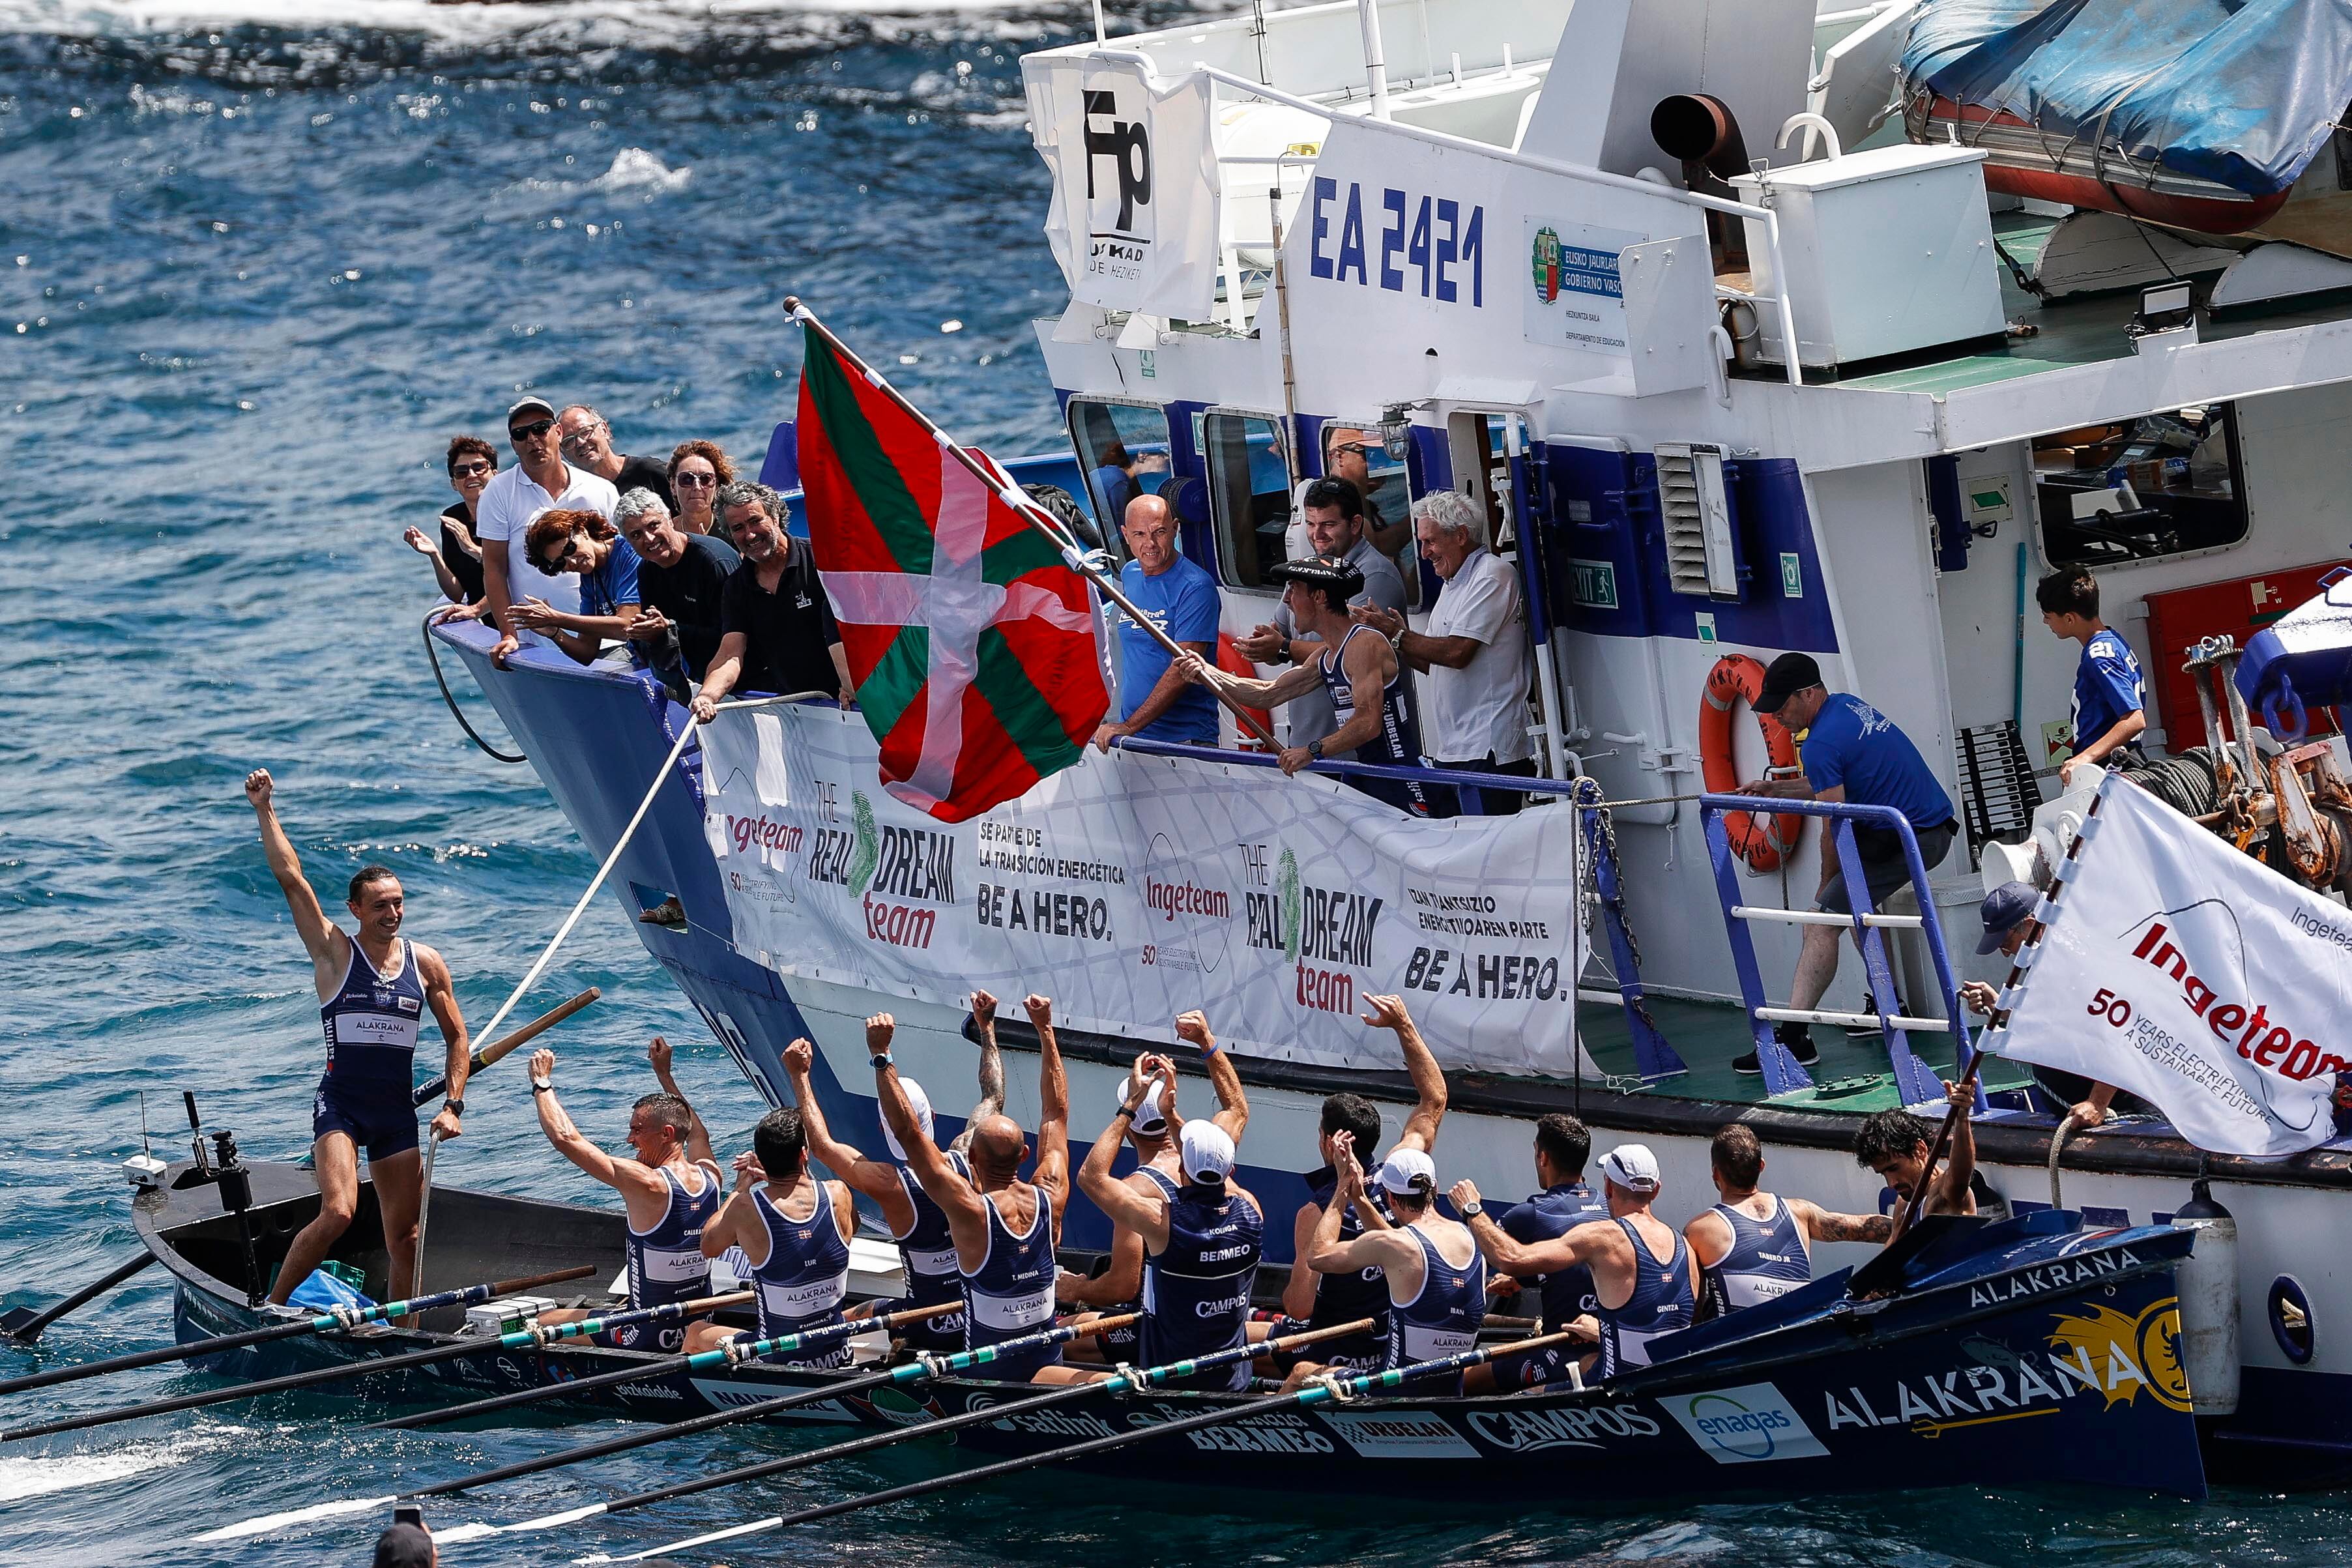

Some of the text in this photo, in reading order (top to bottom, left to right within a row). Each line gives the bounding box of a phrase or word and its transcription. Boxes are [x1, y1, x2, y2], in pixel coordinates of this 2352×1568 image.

[1311, 176, 1485, 308] EA 2421
[1565, 250, 1619, 270] EUSKO JAURLAR
[1565, 272, 1622, 293] GOBIERNO VASC
[1565, 310, 1588, 321] HEZKUNTZA
[1565, 332, 1625, 348] DEPARTAMENTO DE EDUCACIÓN
[2089, 641, 2115, 659] 21
[1384, 714, 1404, 759] URBELAN
[814, 780, 840, 824] THE
[1026, 828, 1041, 849] DE
[808, 825, 955, 904] REAL DREAM
[980, 851, 992, 869] LA
[1058, 858, 1125, 886] ENERGÉTICA
[1238, 843, 1268, 886] THE
[731, 871, 741, 892] 50
[1146, 875, 1230, 922] Ingeteam
[1408, 888, 1432, 907] IZAN
[864, 891, 936, 950] team
[978, 883, 1112, 942] BE A HERO.
[1302, 886, 1384, 968] DREAM
[1509, 920, 1550, 940] PARTE
[1142, 945, 1156, 965] 50
[1296, 957, 1352, 1016] team
[1404, 947, 1567, 1002] BE A HERO.
[356, 1021, 405, 1033] ALAKRANA
[2087, 988, 2131, 1028] 50
[2132, 1014, 2173, 1053] YEARS
[325, 1017, 334, 1060] satlink
[2124, 1027, 2274, 1126] A SUSTAINABLE FUTURE
[804, 1258, 817, 1267] LUR
[1199, 1244, 1251, 1262] BERMEO
[1017, 1270, 1039, 1281] MEDINA
[1971, 1248, 2142, 1308] ALAKRANA
[787, 1283, 839, 1302] ALAKRANA
[1195, 1292, 1247, 1318] CAMPOS
[1002, 1298, 1048, 1314] ALAKRANA
[1657, 1304, 1679, 1313] GENTZA
[1432, 1337, 1472, 1347] ALAKRANA
[1825, 1341, 2149, 1430] ALAKRANA
[1013, 1408, 1119, 1437] satlink
[1356, 1421, 1456, 1437] URBELAN
[1466, 1404, 1661, 1447] CAMPOS
[1696, 1408, 1791, 1438] enagas
[1186, 1427, 1334, 1453] BERMEO
